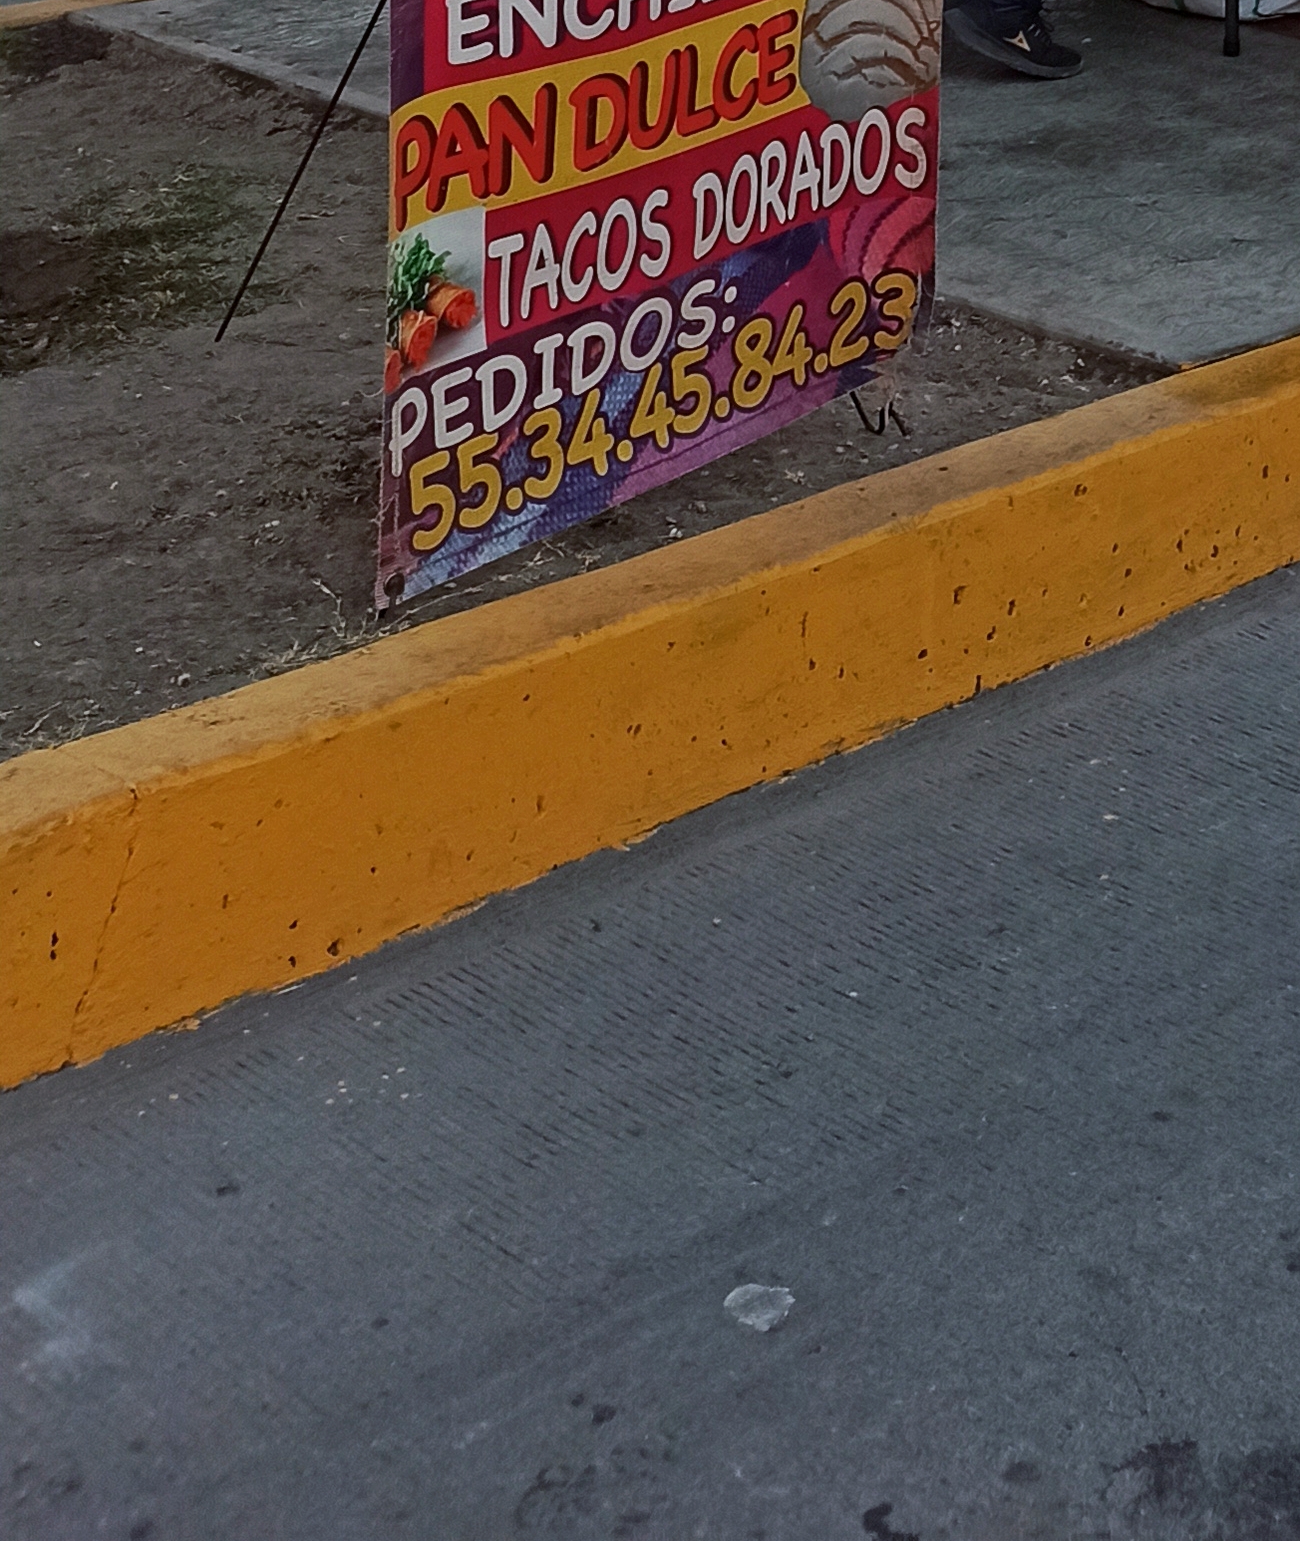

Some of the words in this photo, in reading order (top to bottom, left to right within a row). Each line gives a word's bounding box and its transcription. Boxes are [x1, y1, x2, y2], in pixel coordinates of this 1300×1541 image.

[394, 81, 559, 232] PAN
[568, 8, 800, 172] DULCE
[487, 188, 671, 328] TACOS
[692, 106, 928, 261] DORADOS
[388, 278, 738, 477] PEDIDOS:
[408, 272, 918, 551] 55.34.45.84.23
